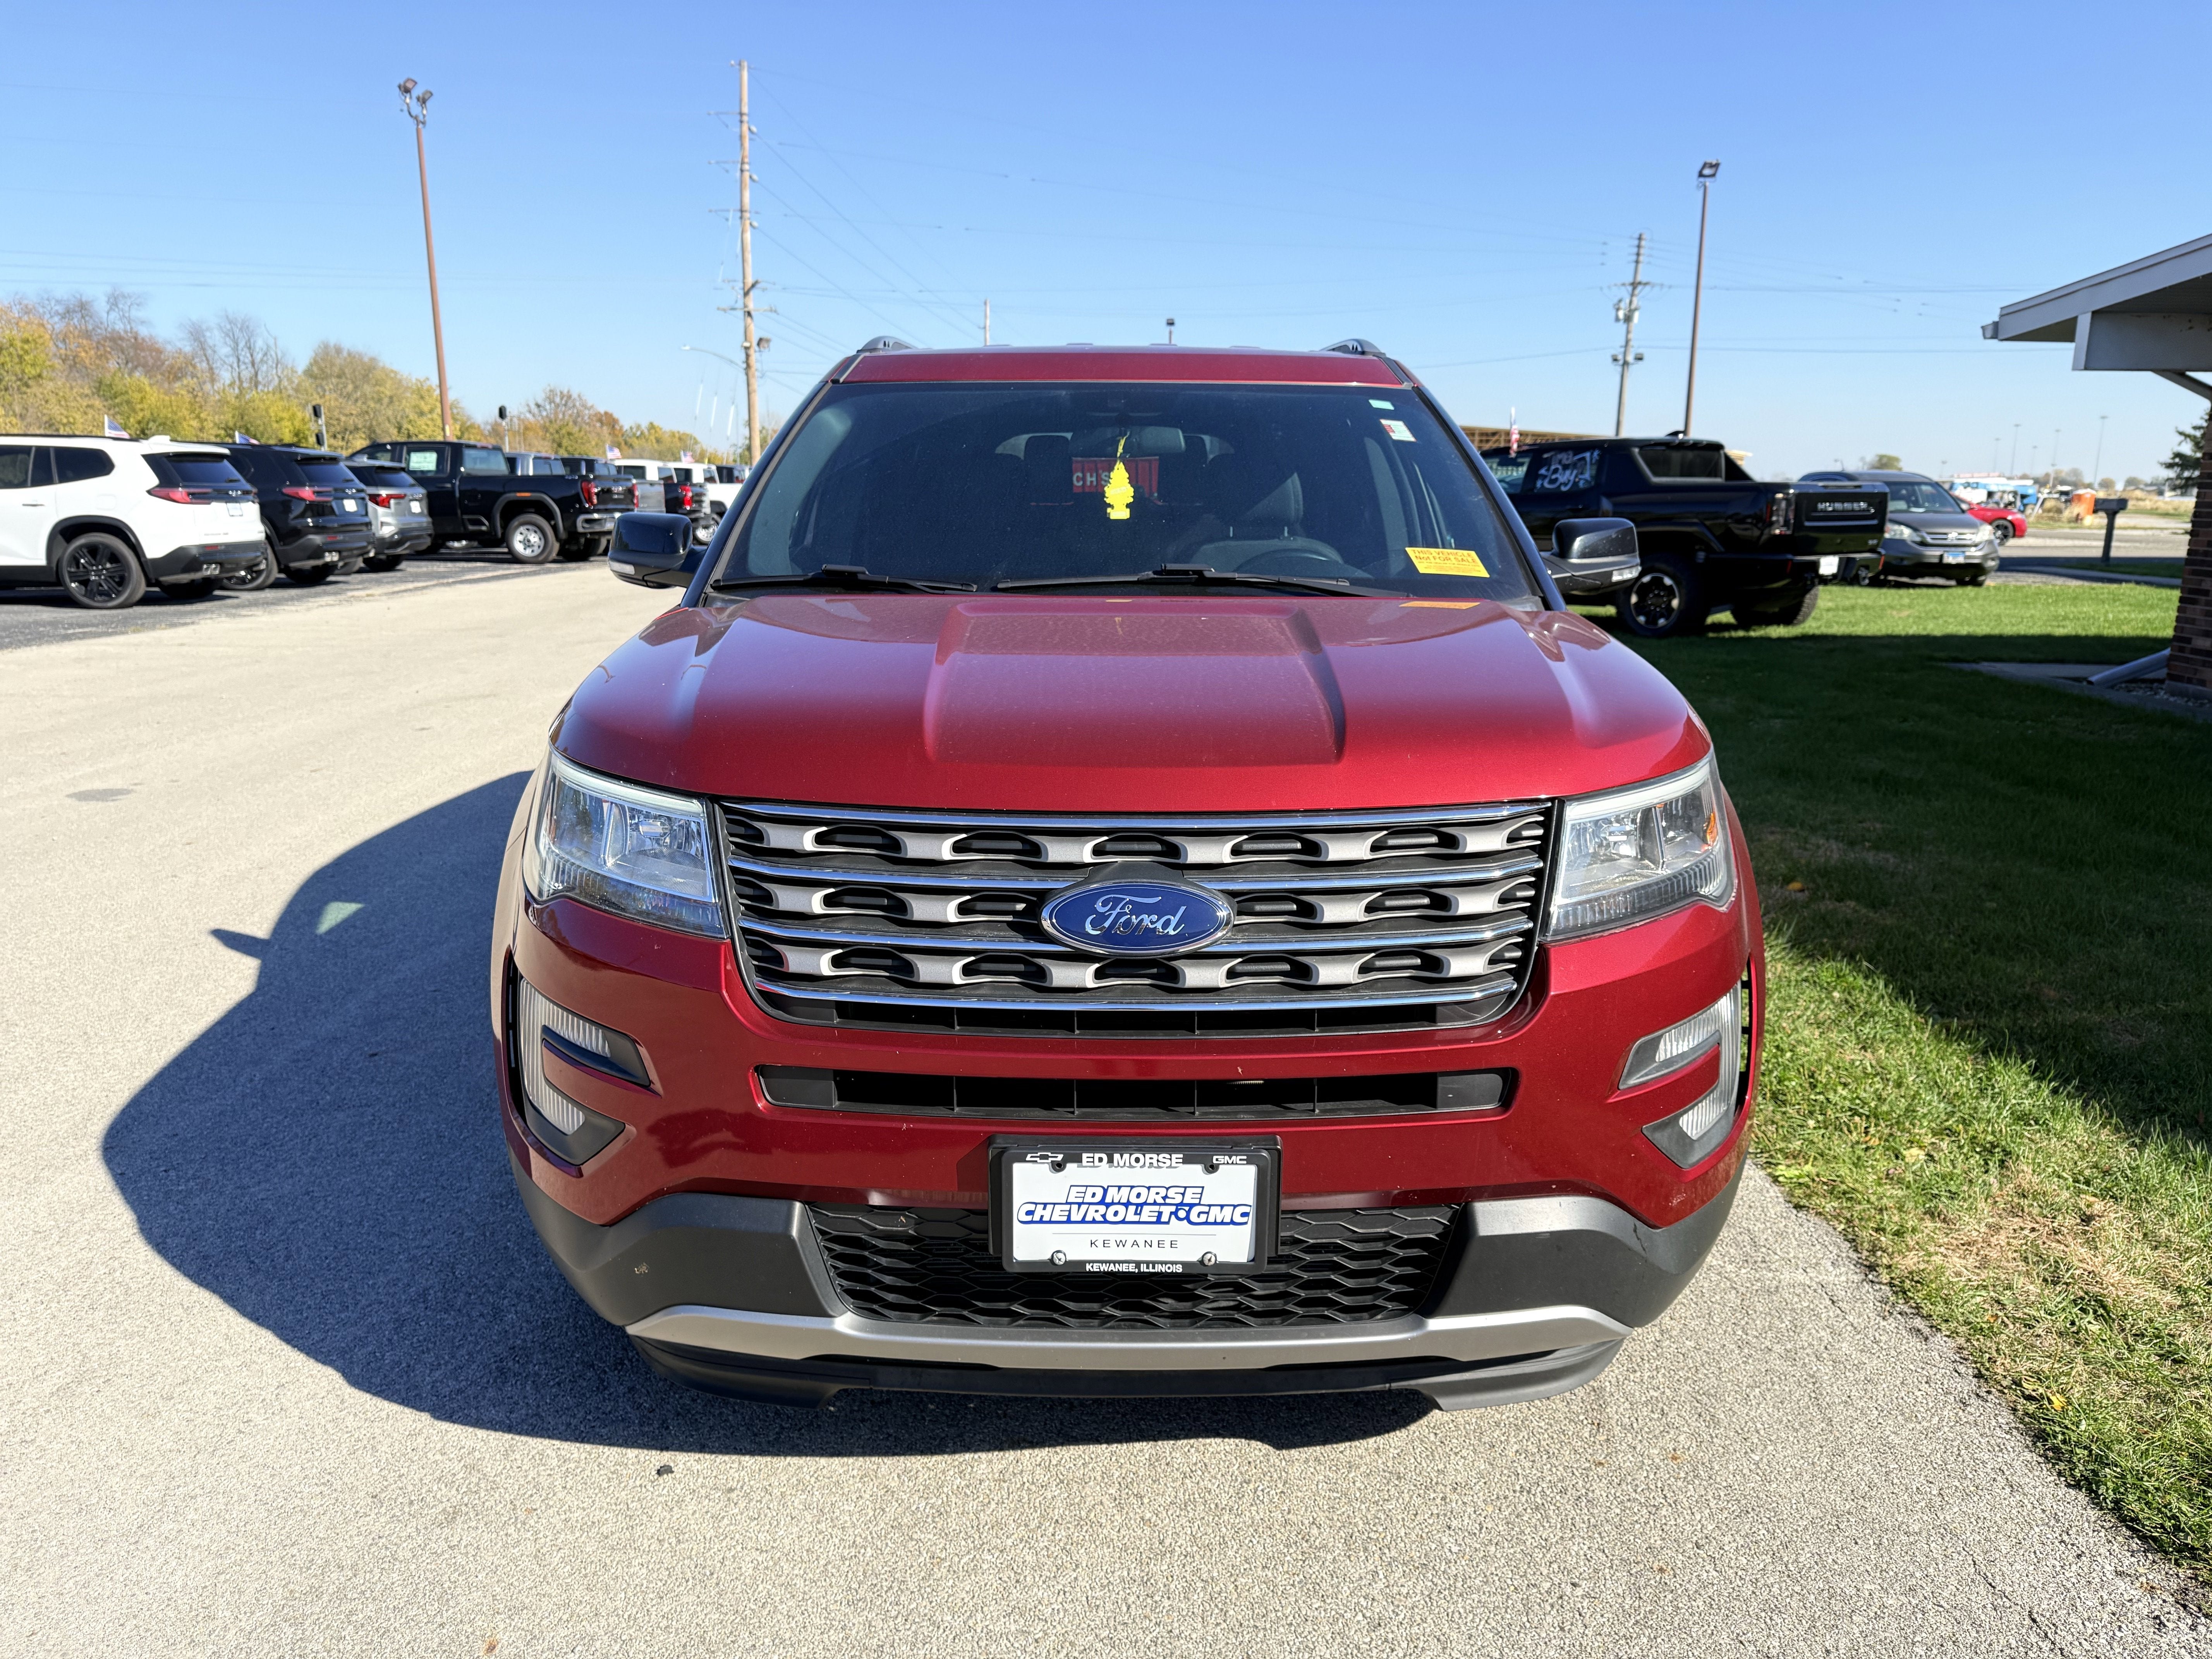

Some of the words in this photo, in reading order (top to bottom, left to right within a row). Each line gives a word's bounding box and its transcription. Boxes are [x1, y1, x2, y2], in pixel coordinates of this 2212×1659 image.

[1085, 894, 1187, 935] Ford
[1082, 1153, 1108, 1166] ED
[1113, 1153, 1183, 1167] MORSE
[1212, 1156, 1247, 1164] GMC
[1066, 1186, 1104, 1203] ED
[1104, 1186, 1203, 1204] MORSE
[1017, 1203, 1176, 1222] CHEVROLET
[1189, 1205, 1251, 1223] GMC
[1090, 1239, 1178, 1249] KEWANEE
[1085, 1262, 1139, 1273] KEWANEE,
[1140, 1263, 1183, 1273] ILLINOIS
